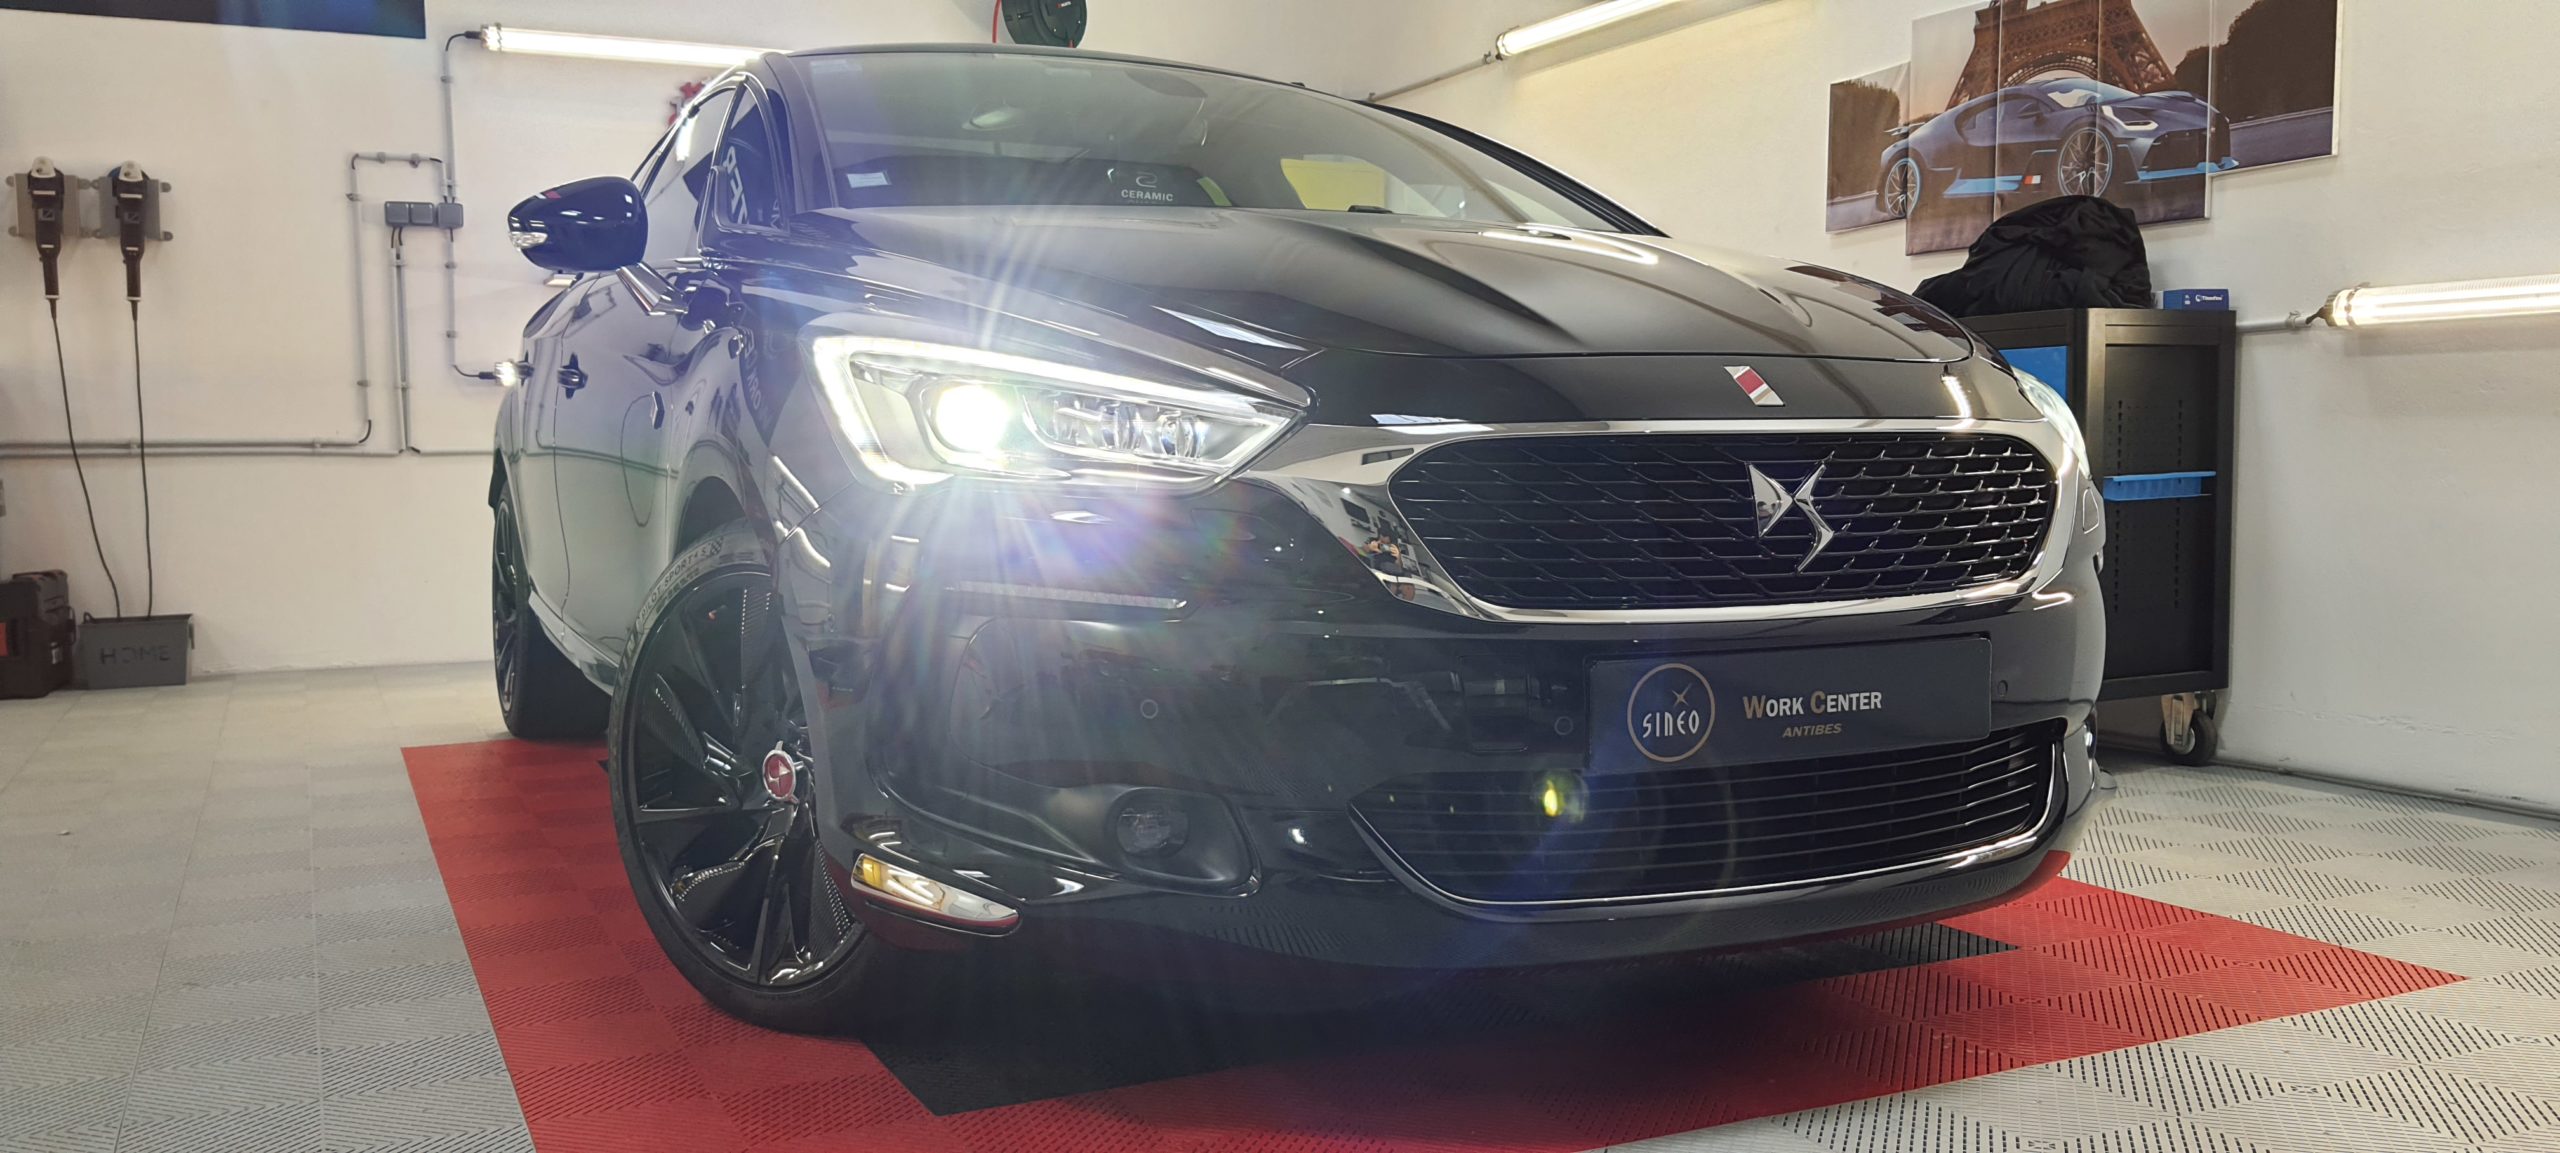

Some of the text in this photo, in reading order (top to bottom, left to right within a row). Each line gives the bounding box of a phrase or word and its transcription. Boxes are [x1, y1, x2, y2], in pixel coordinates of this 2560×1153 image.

[1121, 189, 1174, 201] CERAMIC
[664, 555, 694, 586] SPORT
[1782, 723, 1842, 738] ANTIBES
